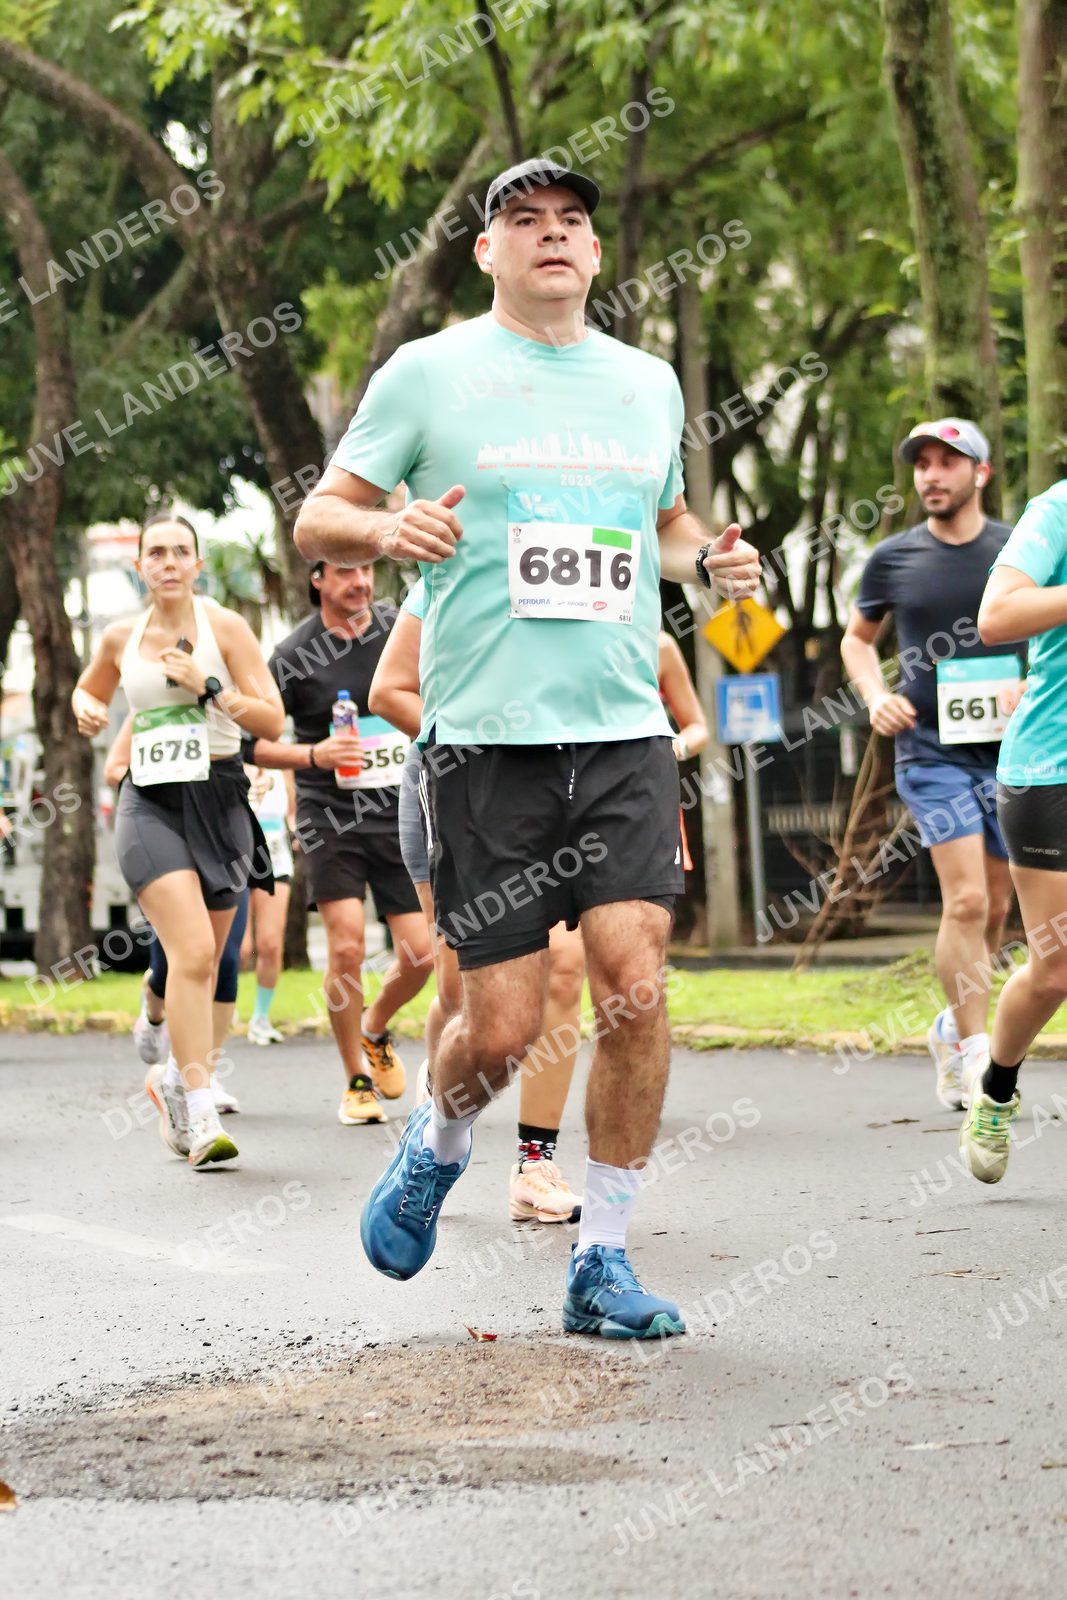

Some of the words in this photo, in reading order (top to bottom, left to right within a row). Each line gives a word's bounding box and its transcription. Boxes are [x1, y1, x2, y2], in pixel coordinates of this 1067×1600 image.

[560, 474, 592, 487] 2025
[519, 546, 633, 591] 6816
[518, 598, 551, 606] PERDURA
[947, 696, 1011, 721] 661
[138, 739, 202, 767] 1678
